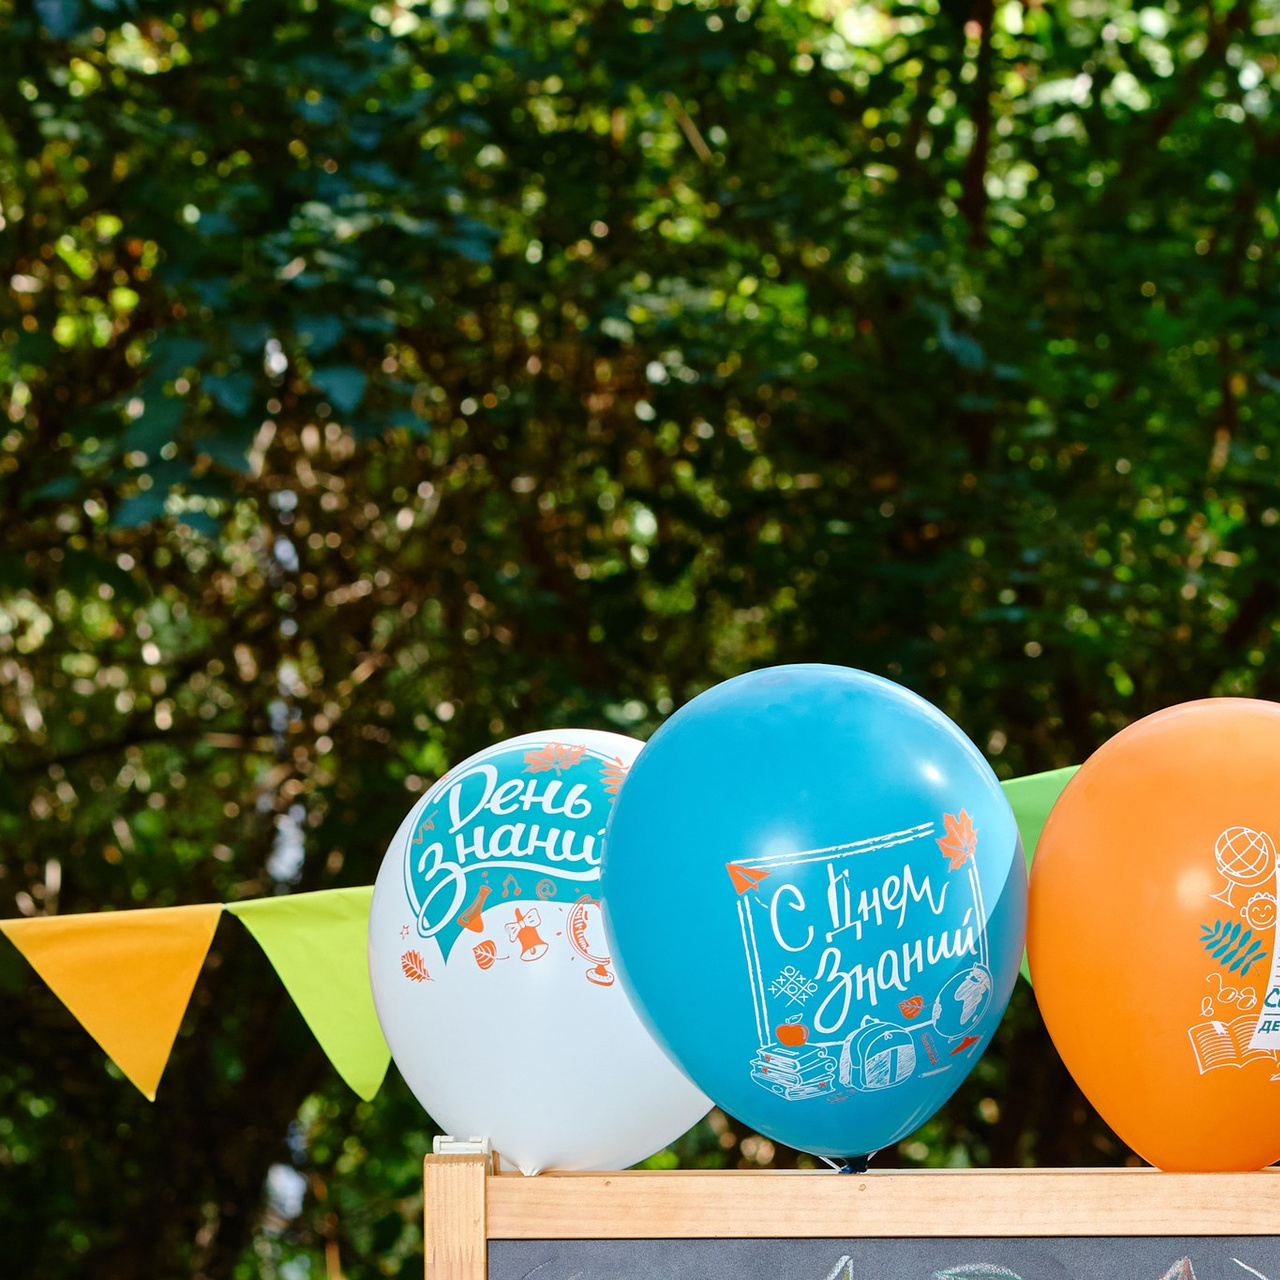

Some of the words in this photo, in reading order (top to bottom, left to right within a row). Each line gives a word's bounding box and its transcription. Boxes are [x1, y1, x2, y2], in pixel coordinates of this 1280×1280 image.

[433, 764, 592, 834] День
[417, 822, 606, 938] Знани
[770, 884, 814, 952] С
[825, 863, 950, 943] Днем
[814, 906, 979, 1034] Знаний
